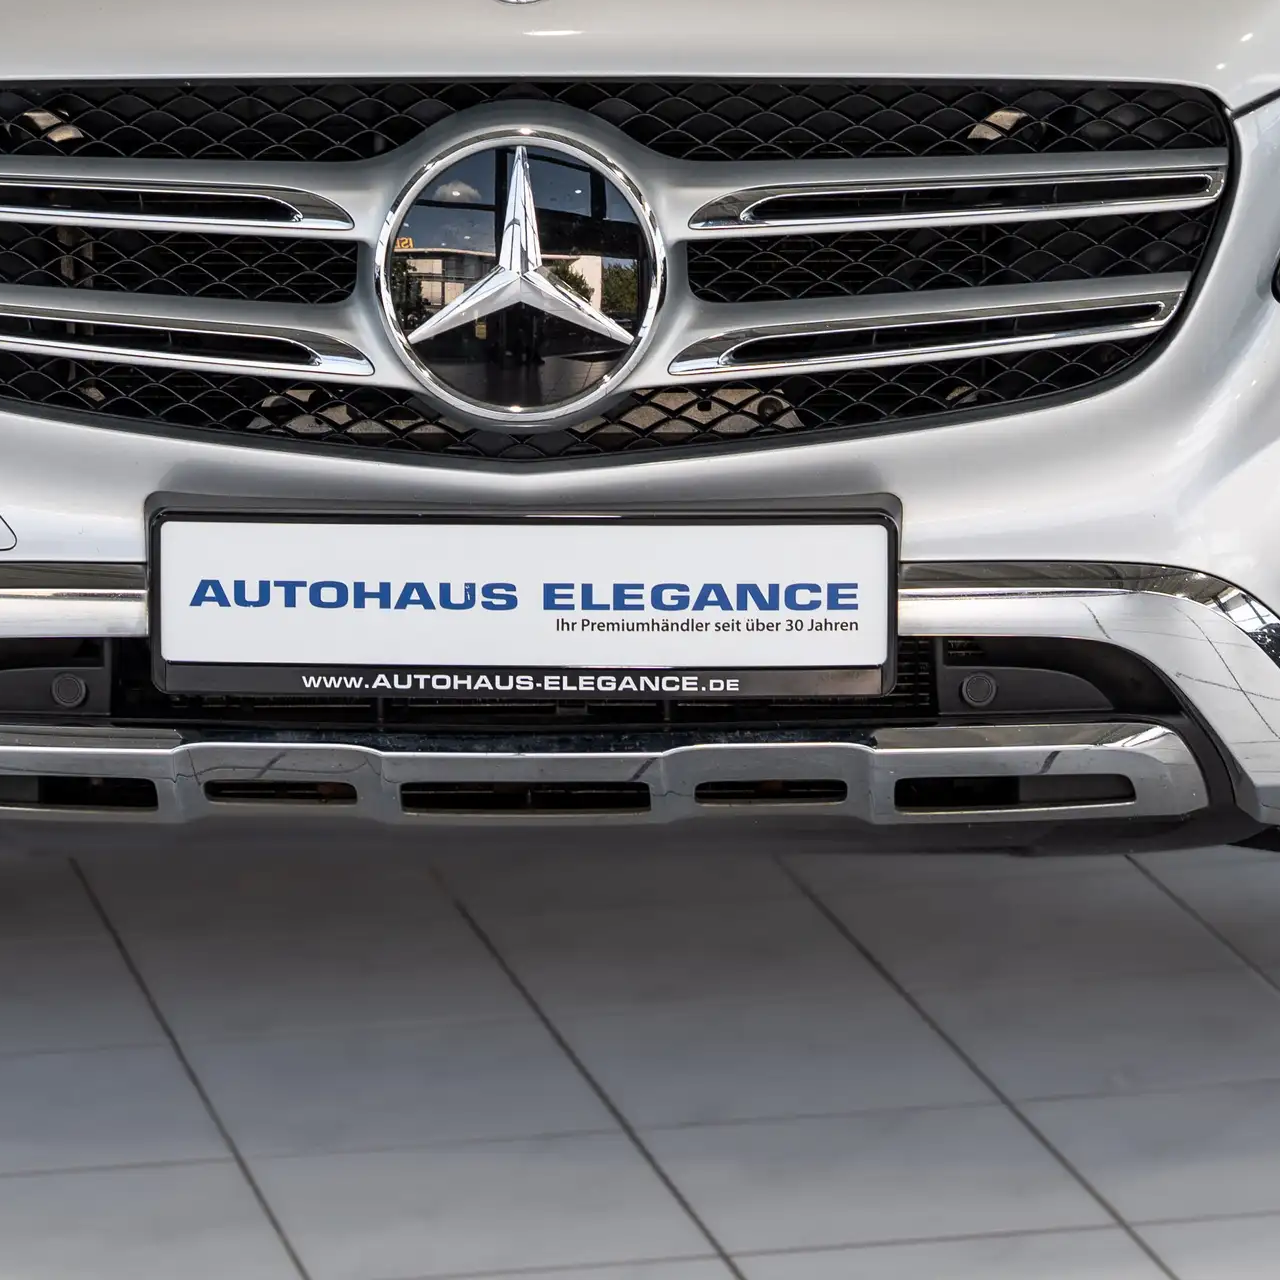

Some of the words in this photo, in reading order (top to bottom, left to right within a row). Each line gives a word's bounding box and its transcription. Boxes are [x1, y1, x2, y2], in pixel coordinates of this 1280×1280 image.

[189, 579, 519, 611] AUTOHAUS
[543, 583, 859, 612] ELEGANCE
[556, 618, 577, 632] Ihr
[582, 618, 710, 632] Premiumhändler
[715, 618, 742, 632] seit
[746, 618, 782, 632] über
[786, 619, 804, 632] 30
[807, 618, 859, 632] Jahren
